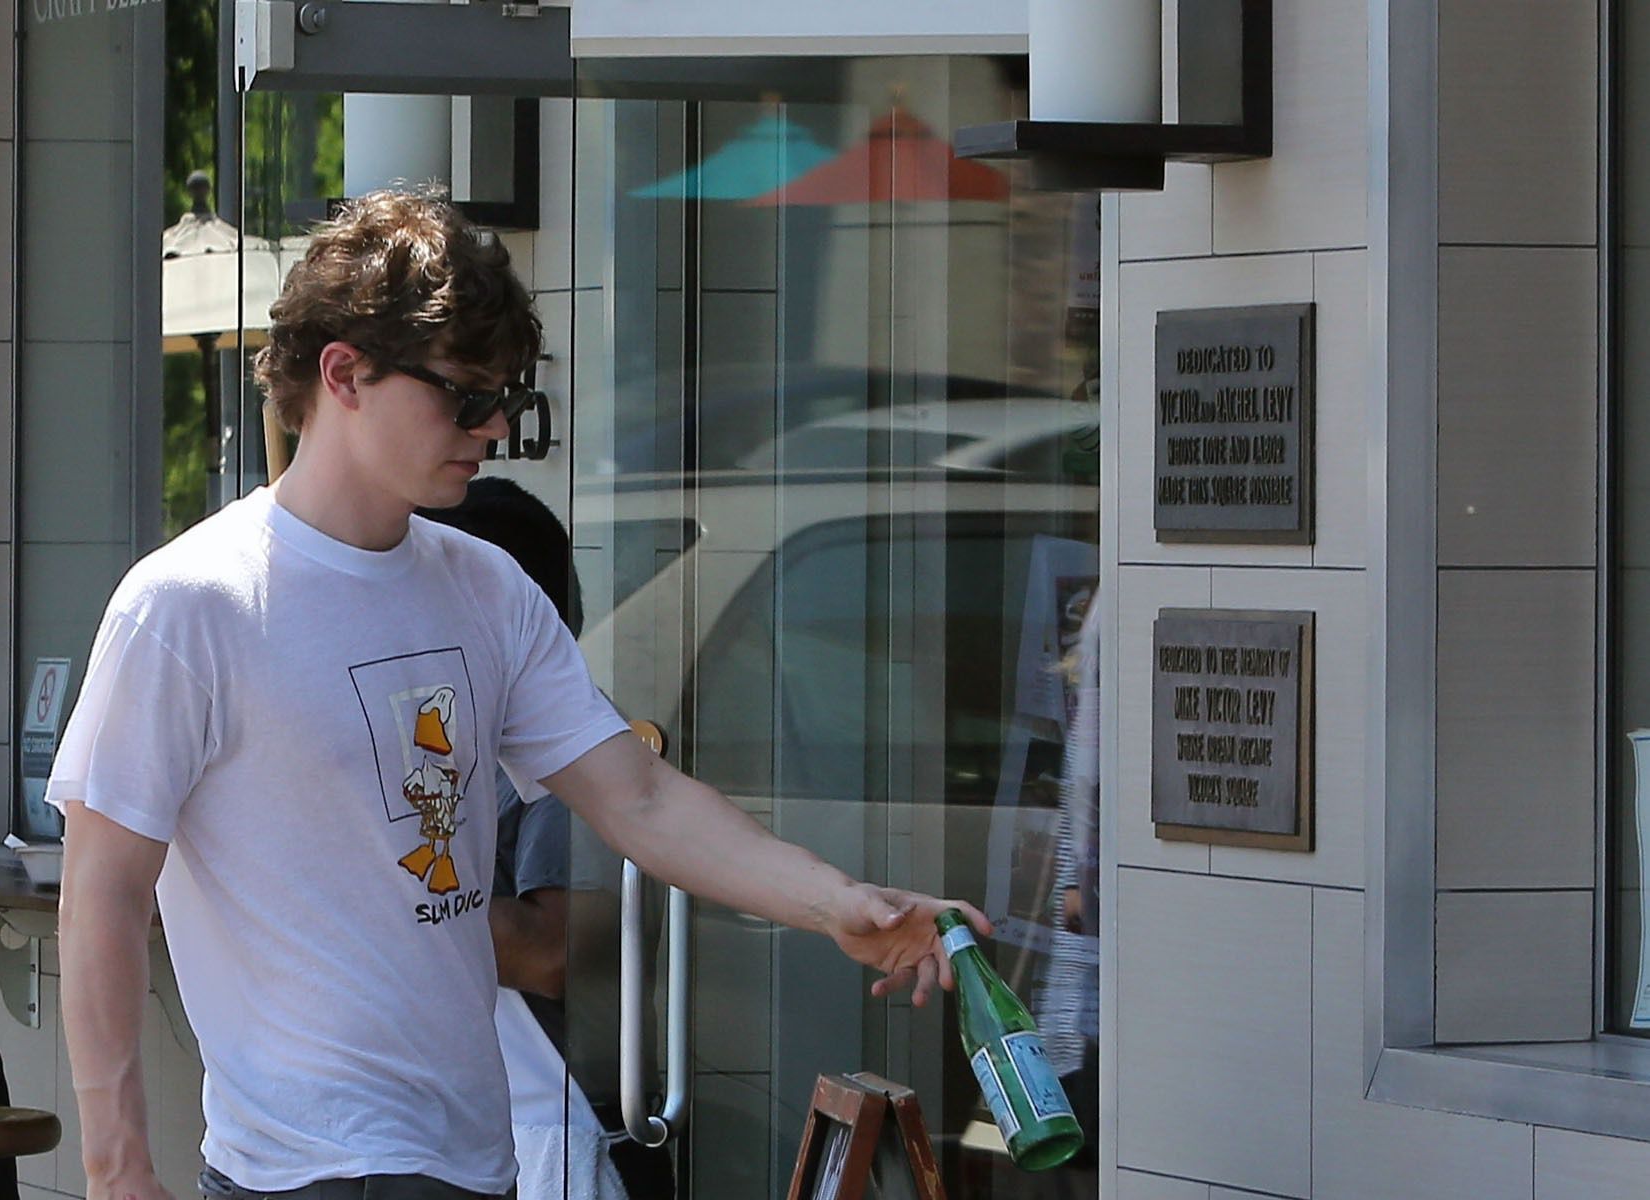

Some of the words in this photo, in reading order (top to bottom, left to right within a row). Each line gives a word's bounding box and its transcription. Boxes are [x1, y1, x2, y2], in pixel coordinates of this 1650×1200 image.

[1177, 345, 1250, 374] DEDICATED
[1256, 345, 1275, 371] TO
[1159, 388, 1200, 425] VICTOR
[1215, 387, 1259, 423] RACHEL
[1263, 386, 1294, 423] LEVY
[1206, 687, 1241, 724] VICTOR
[1246, 690, 1276, 726] LEVY
[415, 898, 451, 925] SLM
